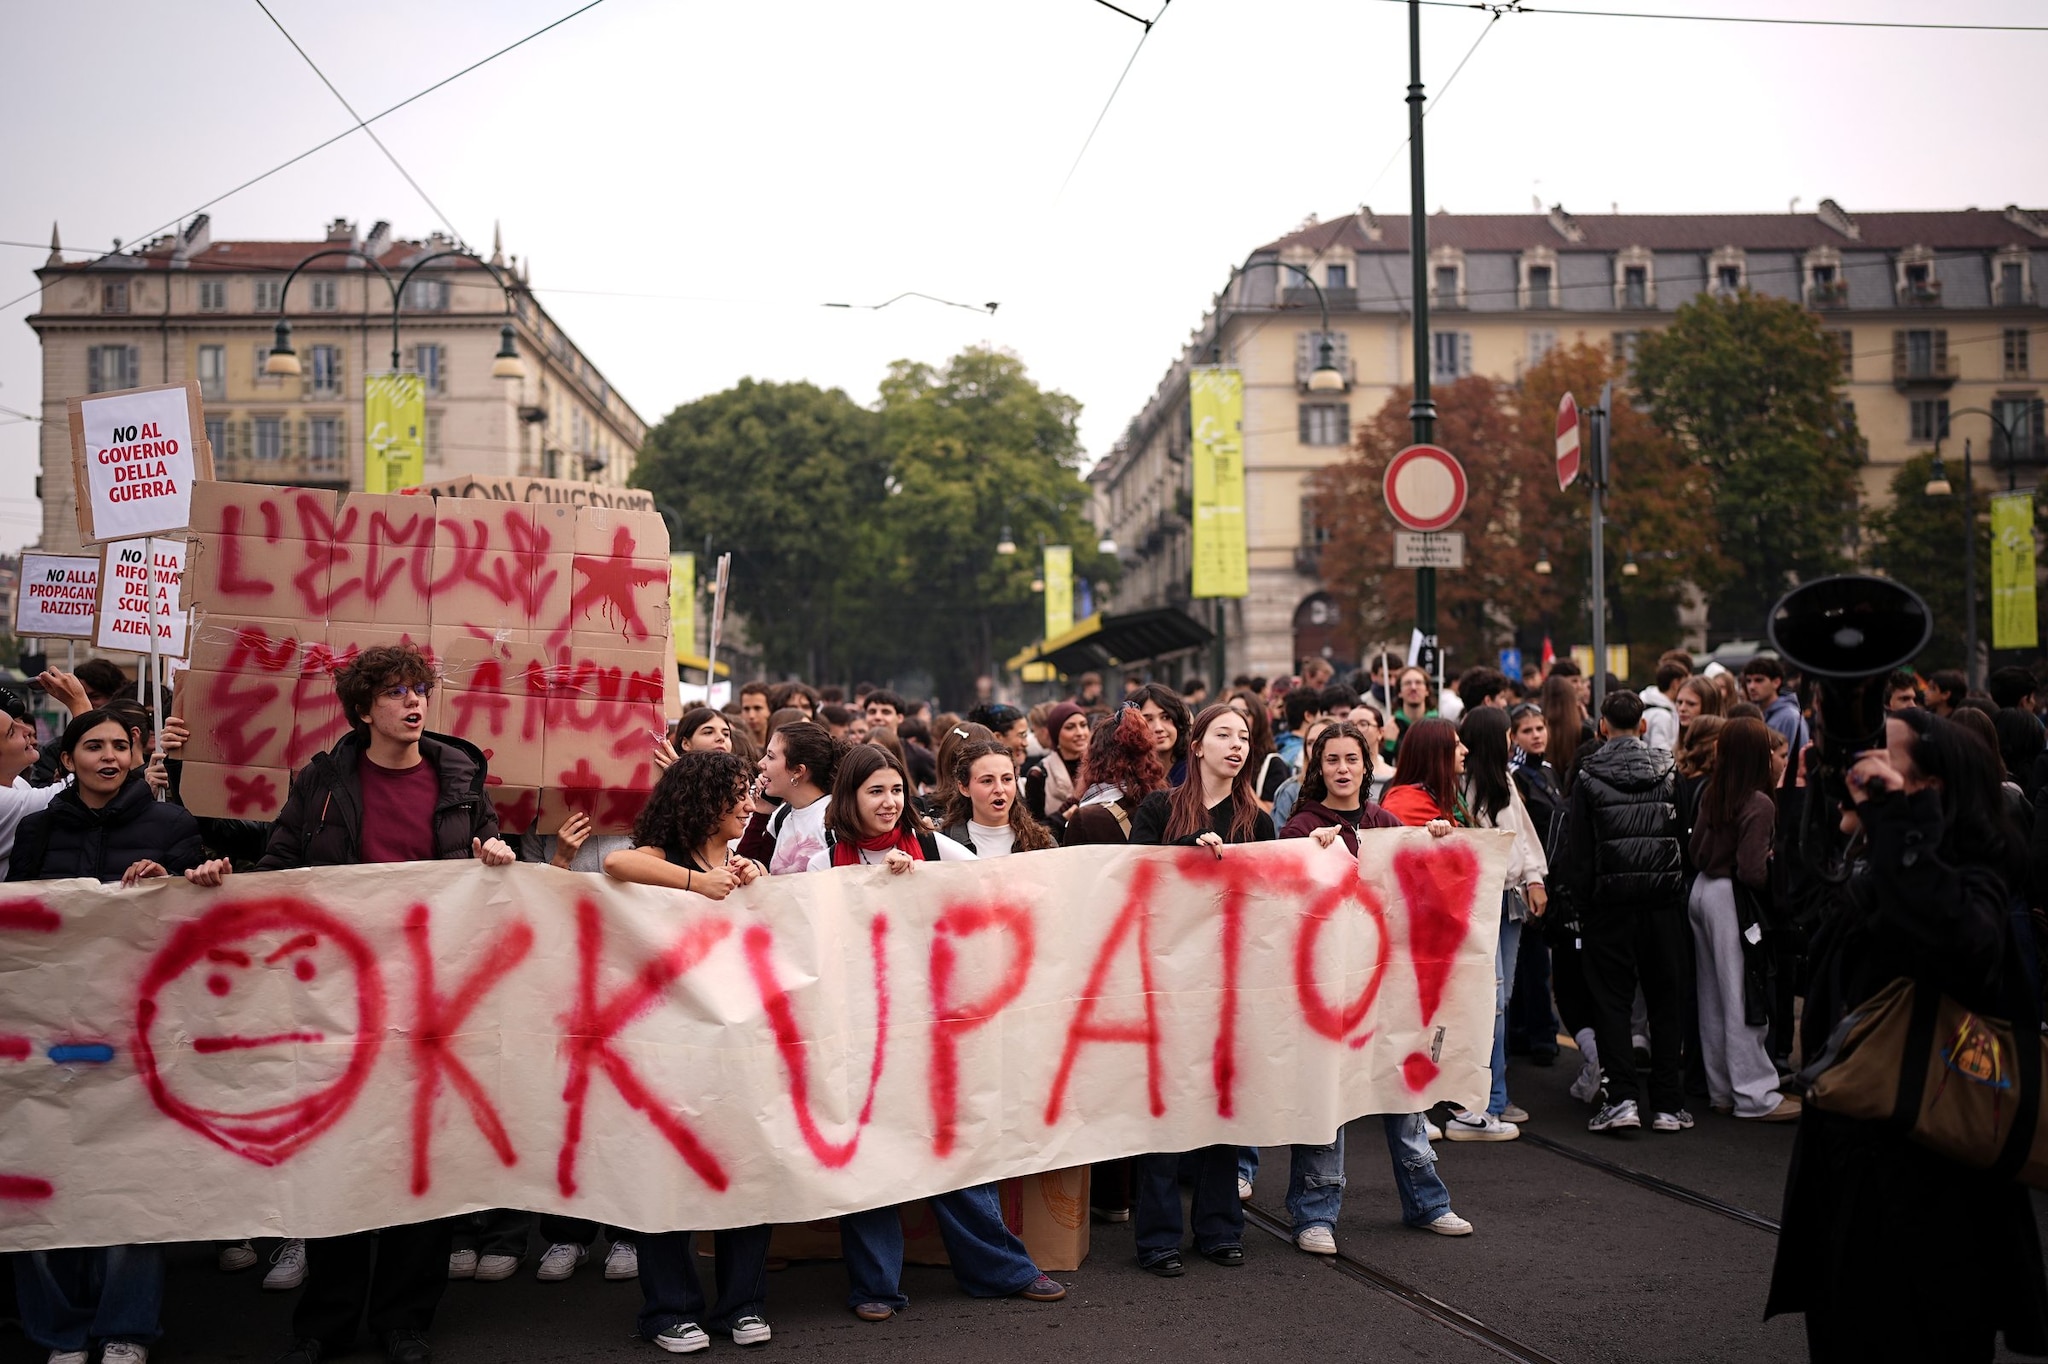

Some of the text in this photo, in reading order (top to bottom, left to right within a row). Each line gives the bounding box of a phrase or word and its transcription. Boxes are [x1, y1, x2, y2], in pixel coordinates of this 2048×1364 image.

[113, 422, 162, 444] NO AL
[98, 439, 179, 465] GOVERNO
[114, 460, 168, 483] DELLA
[109, 479, 177, 503] GUERRA
[120, 548, 178, 569] NO LLA
[46, 569, 96, 584] NO ALLA
[115, 564, 179, 585] RIFOMA
[29, 584, 97, 600] PROPAGAN
[125, 582, 167, 599] DELA
[41, 600, 95, 616] RAZZISTA
